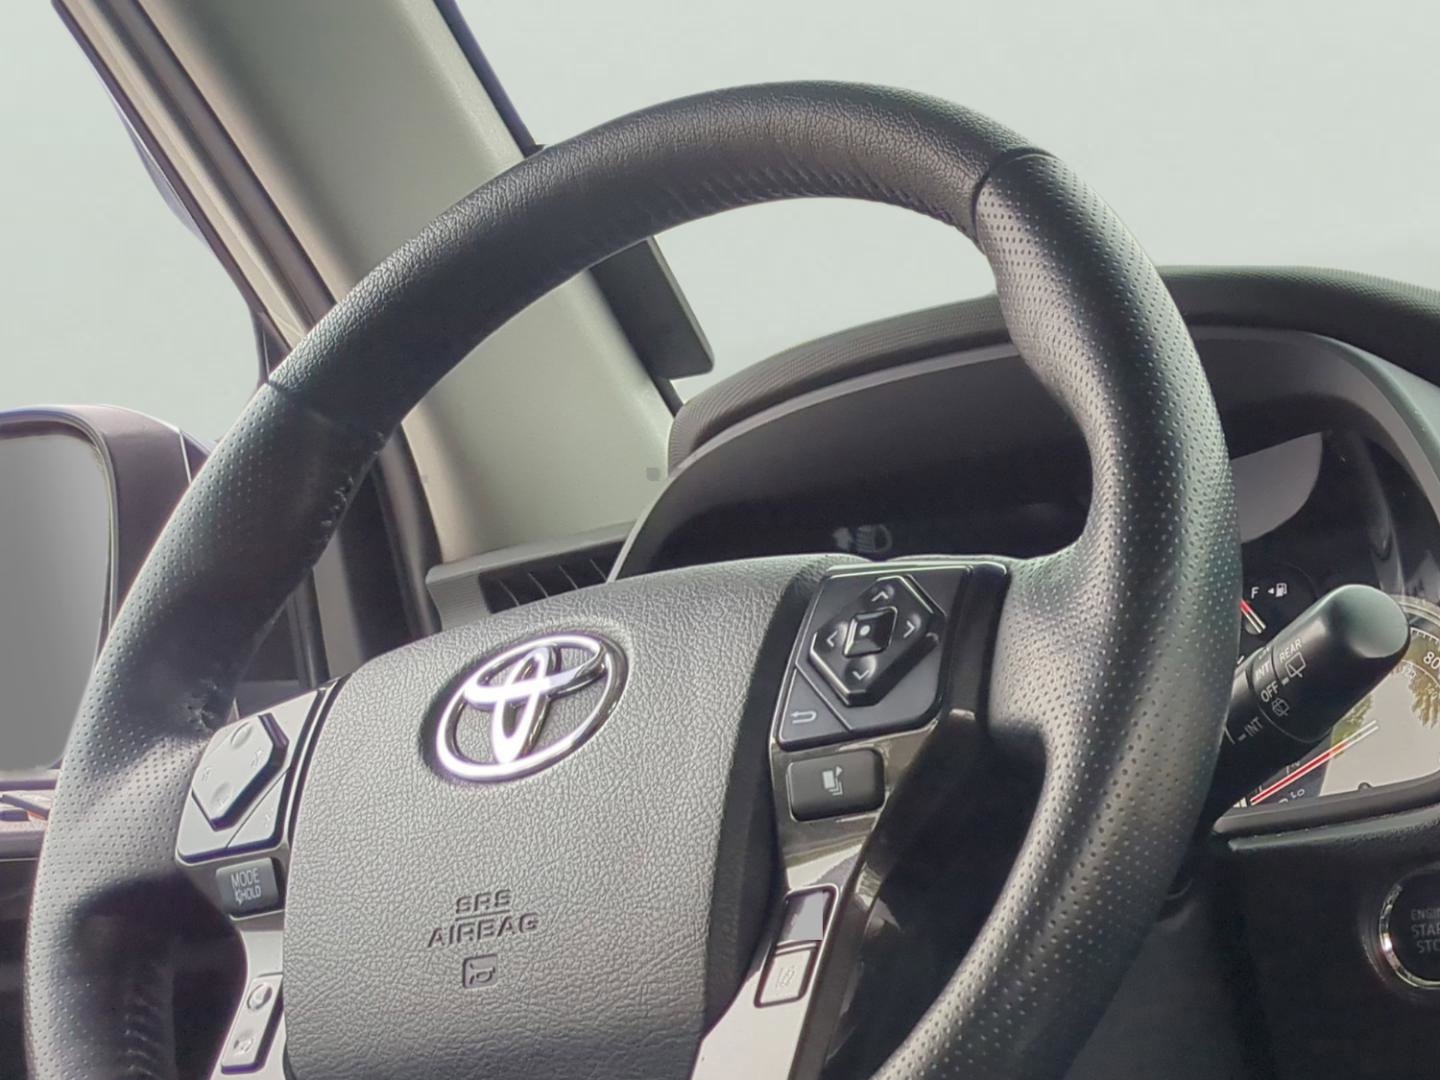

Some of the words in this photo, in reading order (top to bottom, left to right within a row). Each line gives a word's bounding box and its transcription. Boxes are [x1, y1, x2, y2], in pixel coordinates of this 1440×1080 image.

[1251, 586, 1260, 599] F
[1280, 638, 1303, 663] REAR
[1260, 680, 1279, 703] OFF
[1244, 716, 1263, 737] INT
[231, 867, 259, 888] MODE
[455, 889, 511, 914] SRS
[427, 911, 540, 948] AIRBAG
